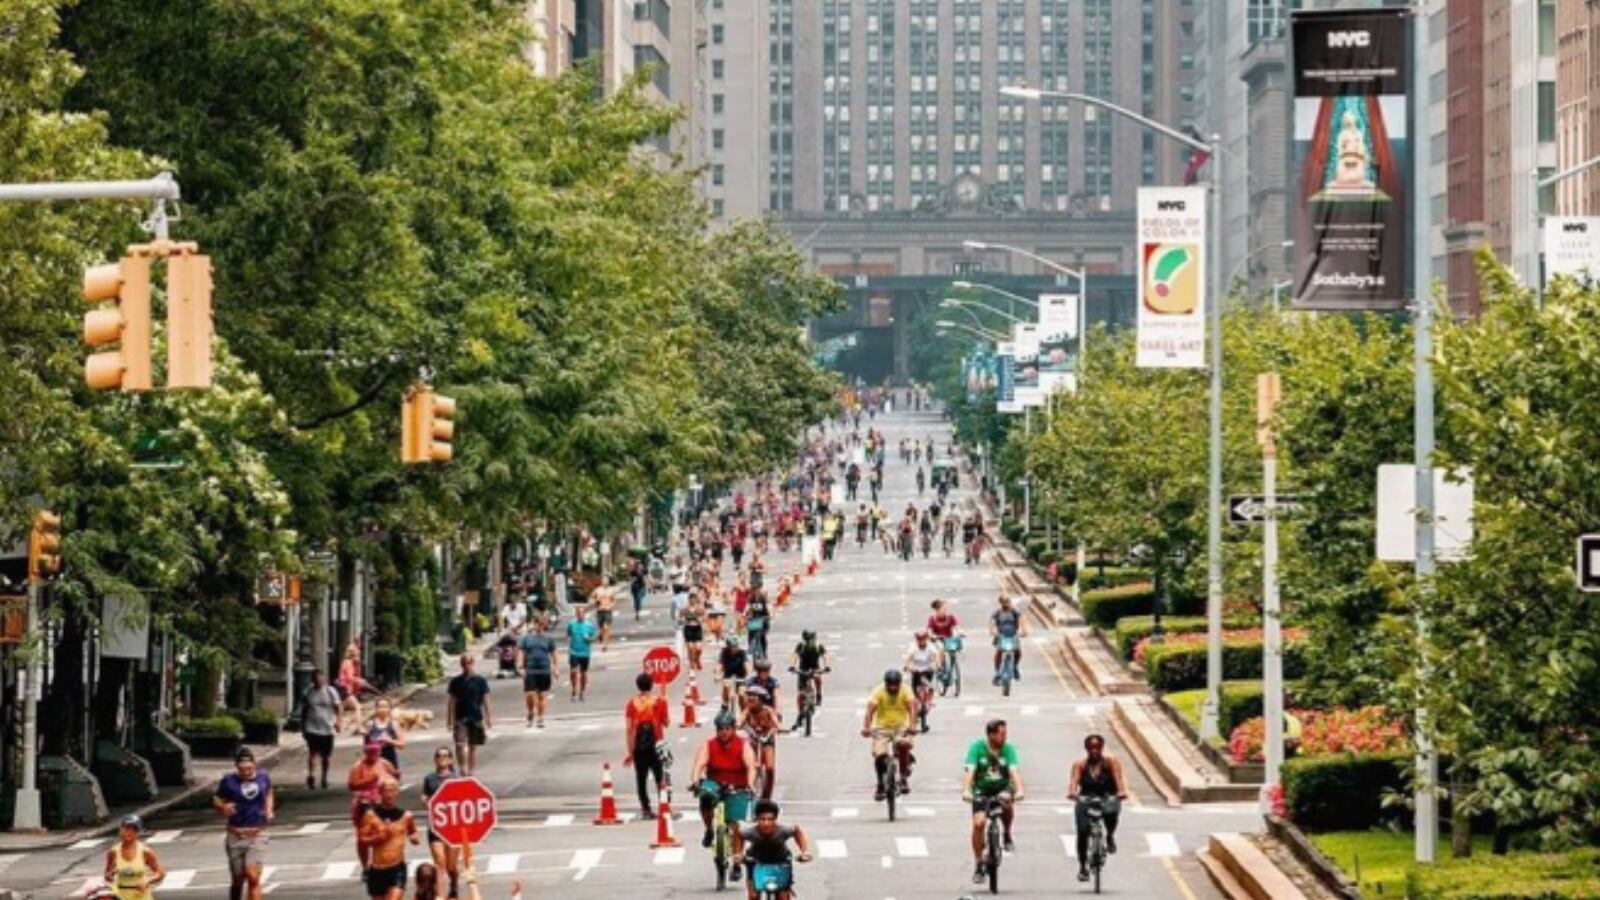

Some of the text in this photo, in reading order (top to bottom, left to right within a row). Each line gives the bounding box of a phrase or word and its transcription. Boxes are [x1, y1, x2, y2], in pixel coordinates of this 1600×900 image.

[1328, 30, 1371, 48] NYC
[1157, 200, 1186, 212] NYC
[1143, 227, 1188, 239] COLOR
[1312, 272, 1376, 289] Sotheby's
[644, 657, 679, 674] STOP
[434, 798, 491, 829] STOP
